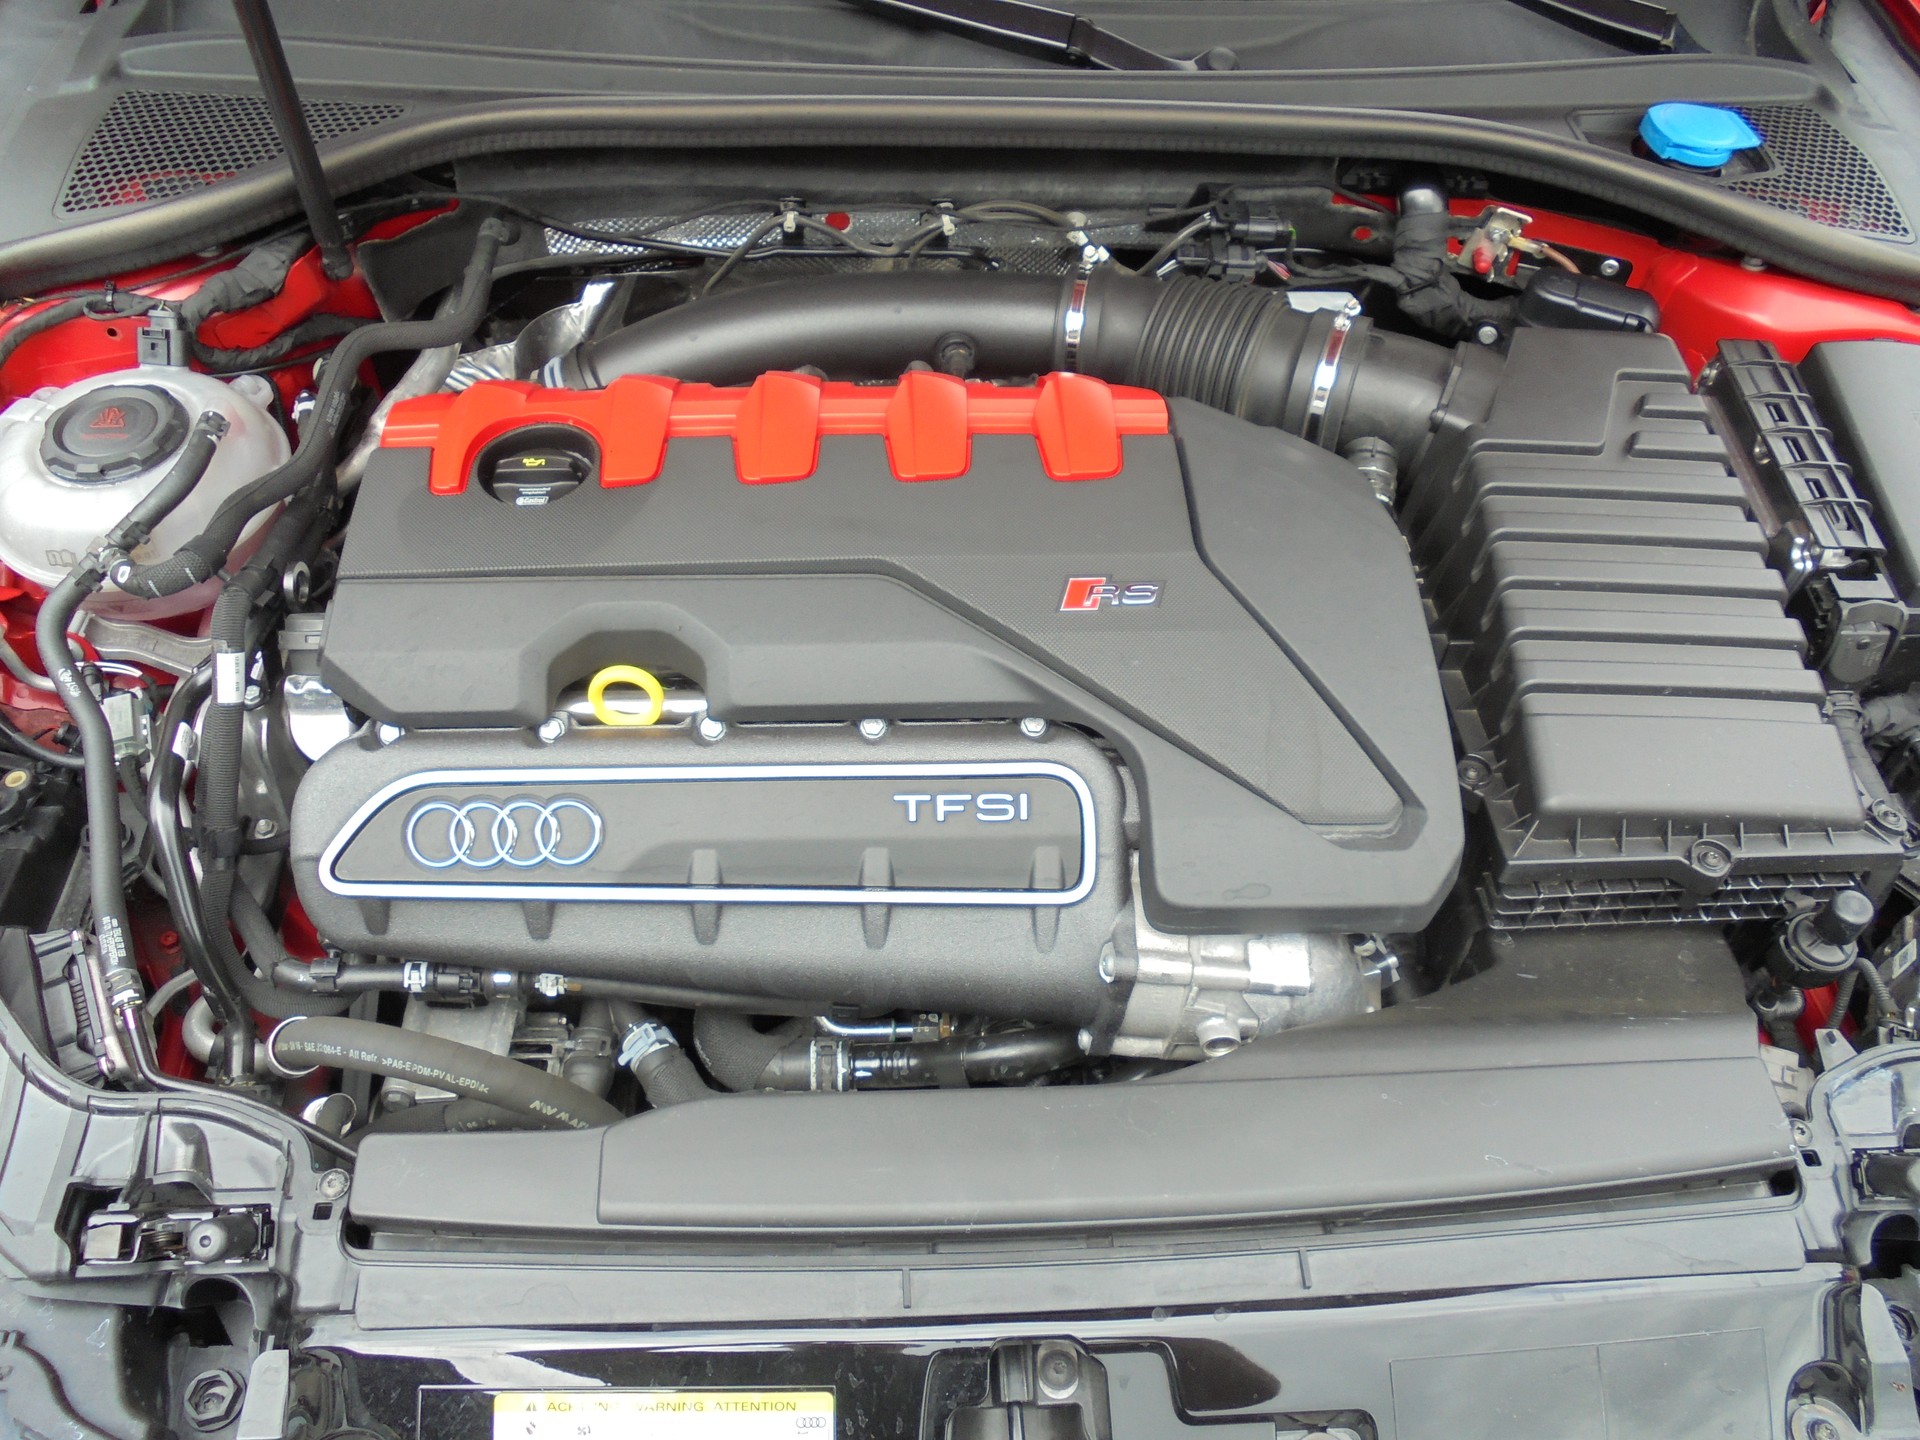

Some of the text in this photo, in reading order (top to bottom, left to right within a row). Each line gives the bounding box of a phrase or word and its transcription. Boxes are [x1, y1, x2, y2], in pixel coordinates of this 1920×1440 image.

[1081, 582, 1159, 606] RS
[893, 793, 1028, 822] TFSI
[348, 1049, 359, 1060] All
[714, 1402, 797, 1412] ATTENTION
